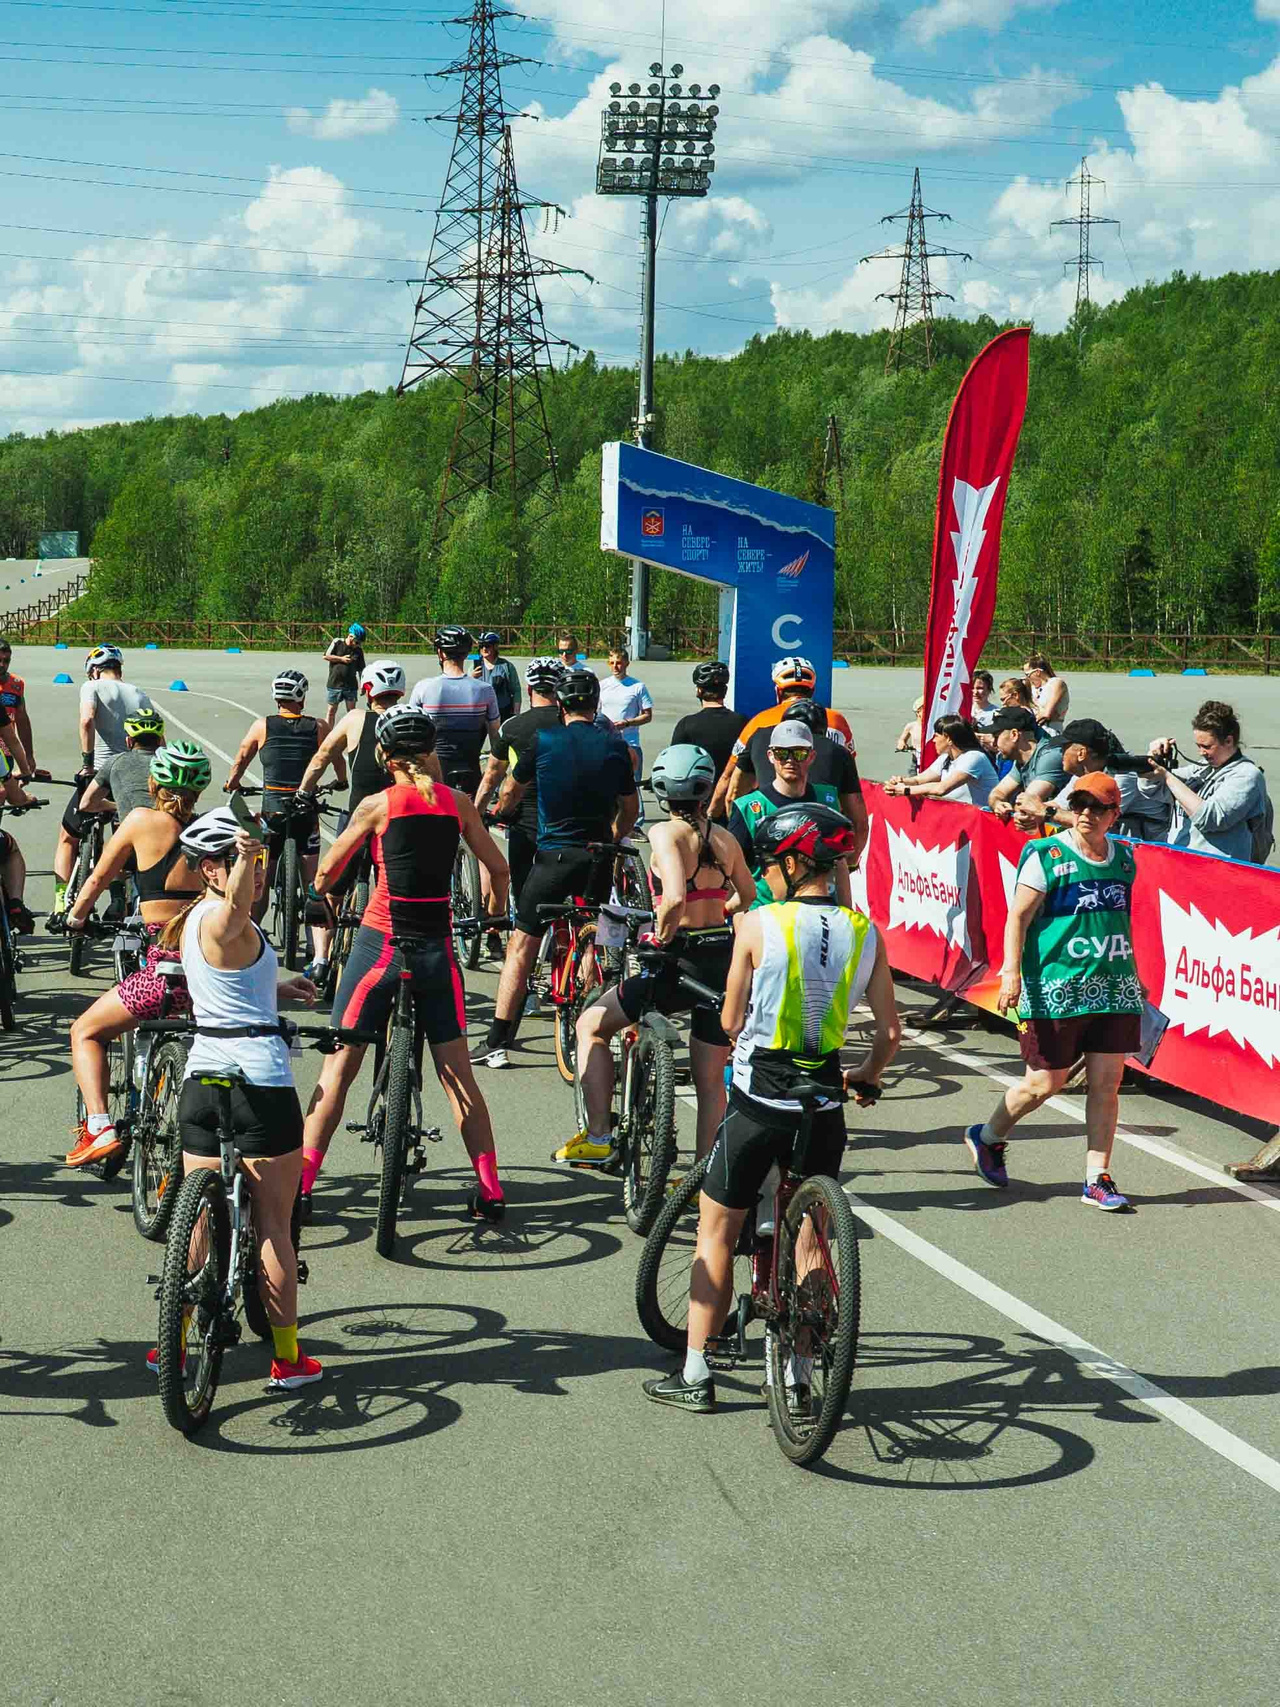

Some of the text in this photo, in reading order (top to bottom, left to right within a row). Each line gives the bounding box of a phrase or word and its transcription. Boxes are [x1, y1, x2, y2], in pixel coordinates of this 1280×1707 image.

[682, 524, 693, 536] НА
[737, 536, 749, 548] НА
[681, 549, 709, 561] СПОРТ!
[737, 561, 764, 573] ЖИТЬ!
[898, 861, 932, 904] Альфа
[931, 872, 962, 909] Банк
[820, 914, 830, 969] RUSH
[1175, 945, 1280, 1012] Альфа Бан
